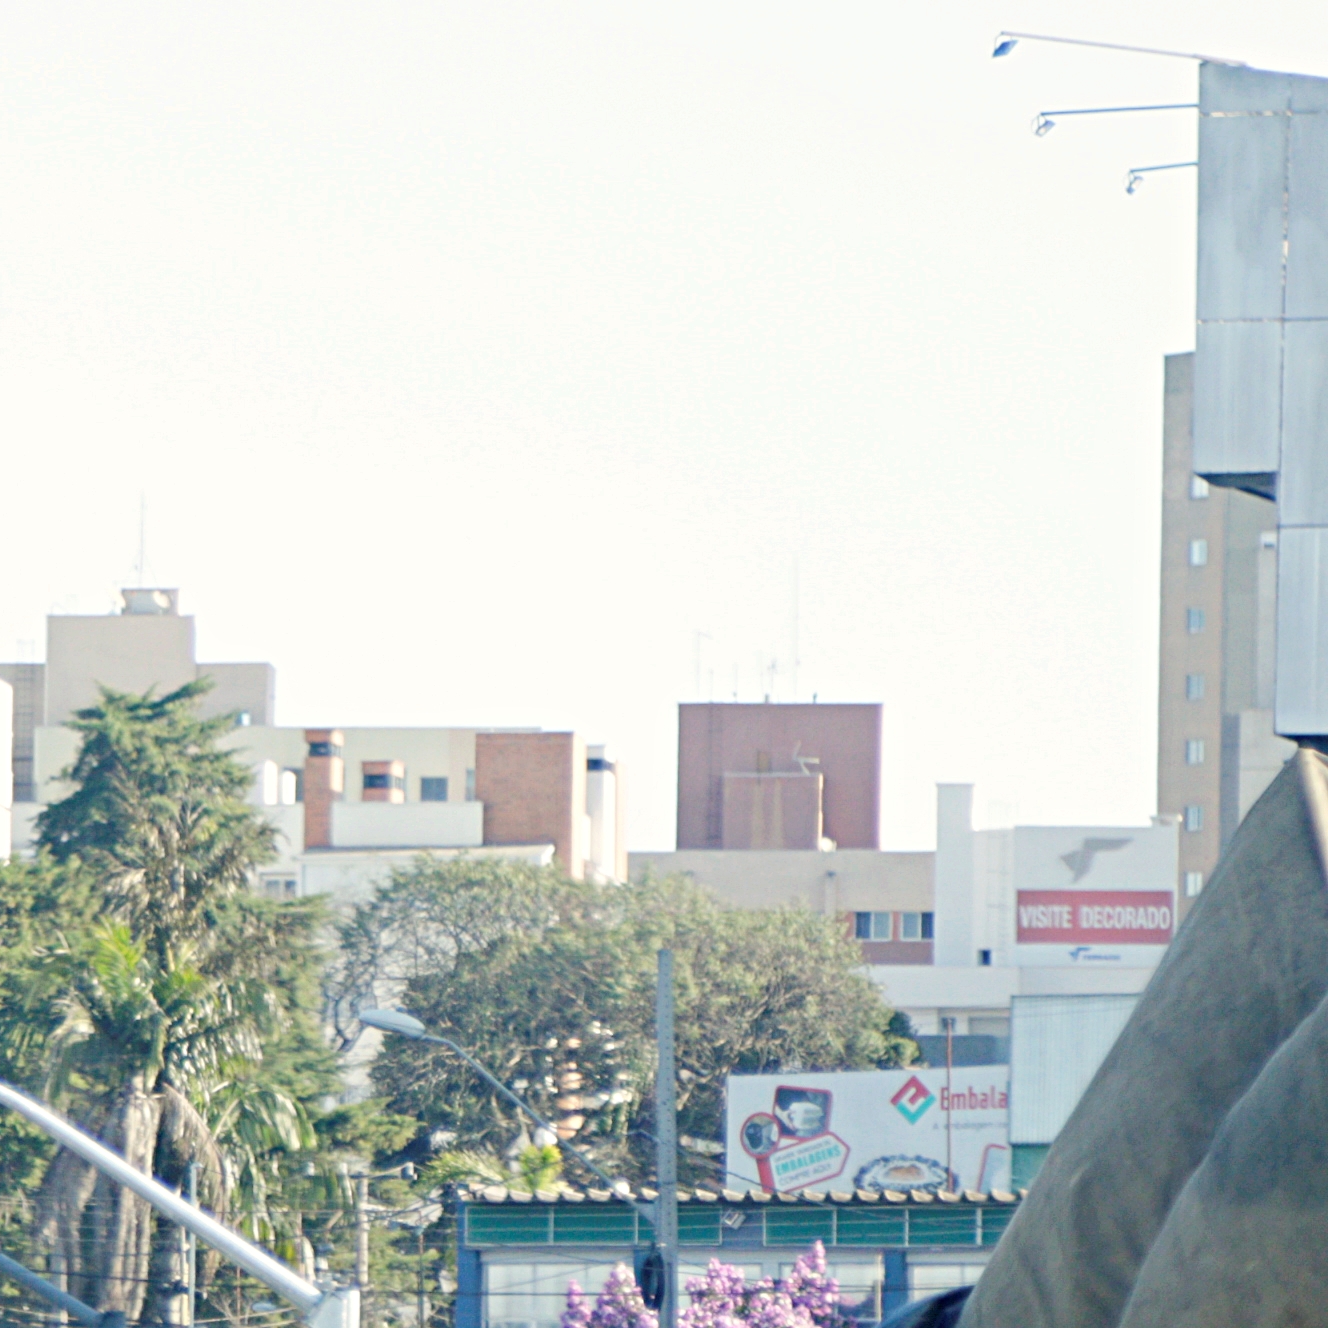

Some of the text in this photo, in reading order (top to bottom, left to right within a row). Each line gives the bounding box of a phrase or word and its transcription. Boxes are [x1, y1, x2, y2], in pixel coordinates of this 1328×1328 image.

[1018, 904, 1171, 930] VISITE DECORADO
[940, 1085, 1008, 1111] Embala
[775, 1144, 842, 1176] EMBALAGENS
